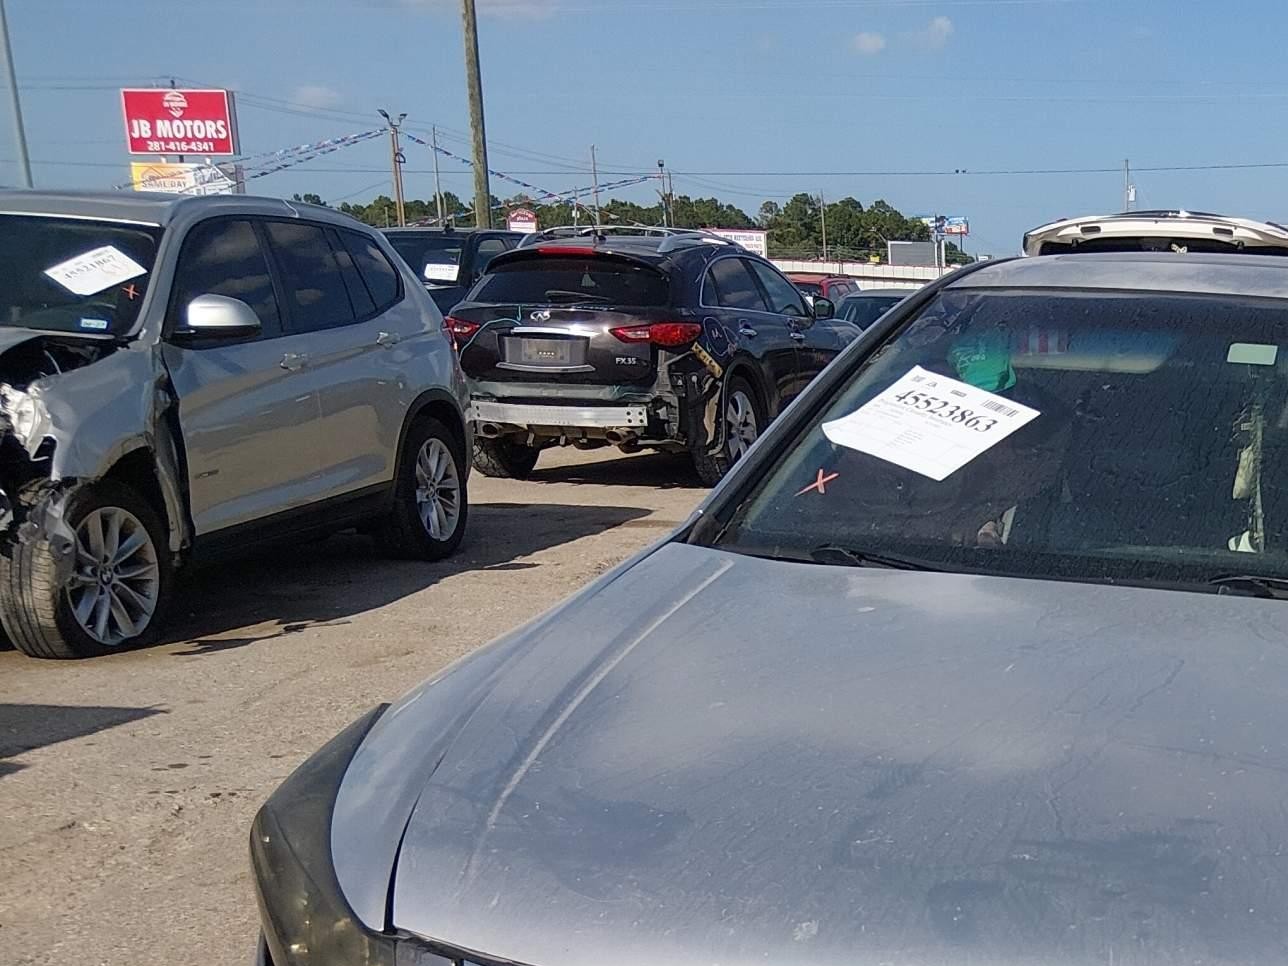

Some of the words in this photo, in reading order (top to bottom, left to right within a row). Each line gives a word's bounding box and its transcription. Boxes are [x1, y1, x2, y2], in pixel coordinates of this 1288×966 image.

[131, 119, 152, 139] JB
[156, 119, 227, 139] MOTORS
[146, 141, 215, 152] 281-416-4341
[615, 357, 637, 365] FX35
[896, 390, 998, 433] 45523863
